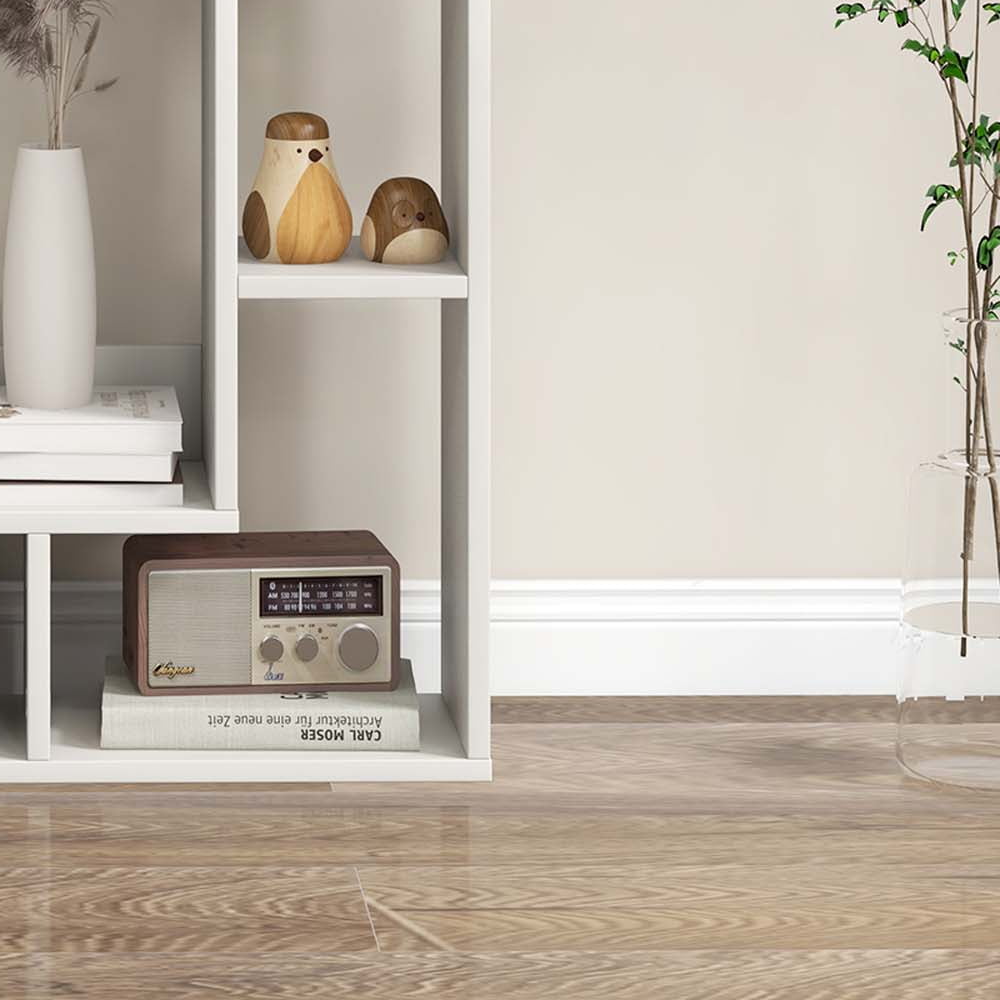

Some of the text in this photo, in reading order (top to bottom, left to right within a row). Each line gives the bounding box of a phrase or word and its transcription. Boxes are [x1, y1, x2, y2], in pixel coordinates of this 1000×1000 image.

[208, 715, 383, 728] Architektur für eine neue Zeit
[300, 729, 382, 742] CARL MOSER
